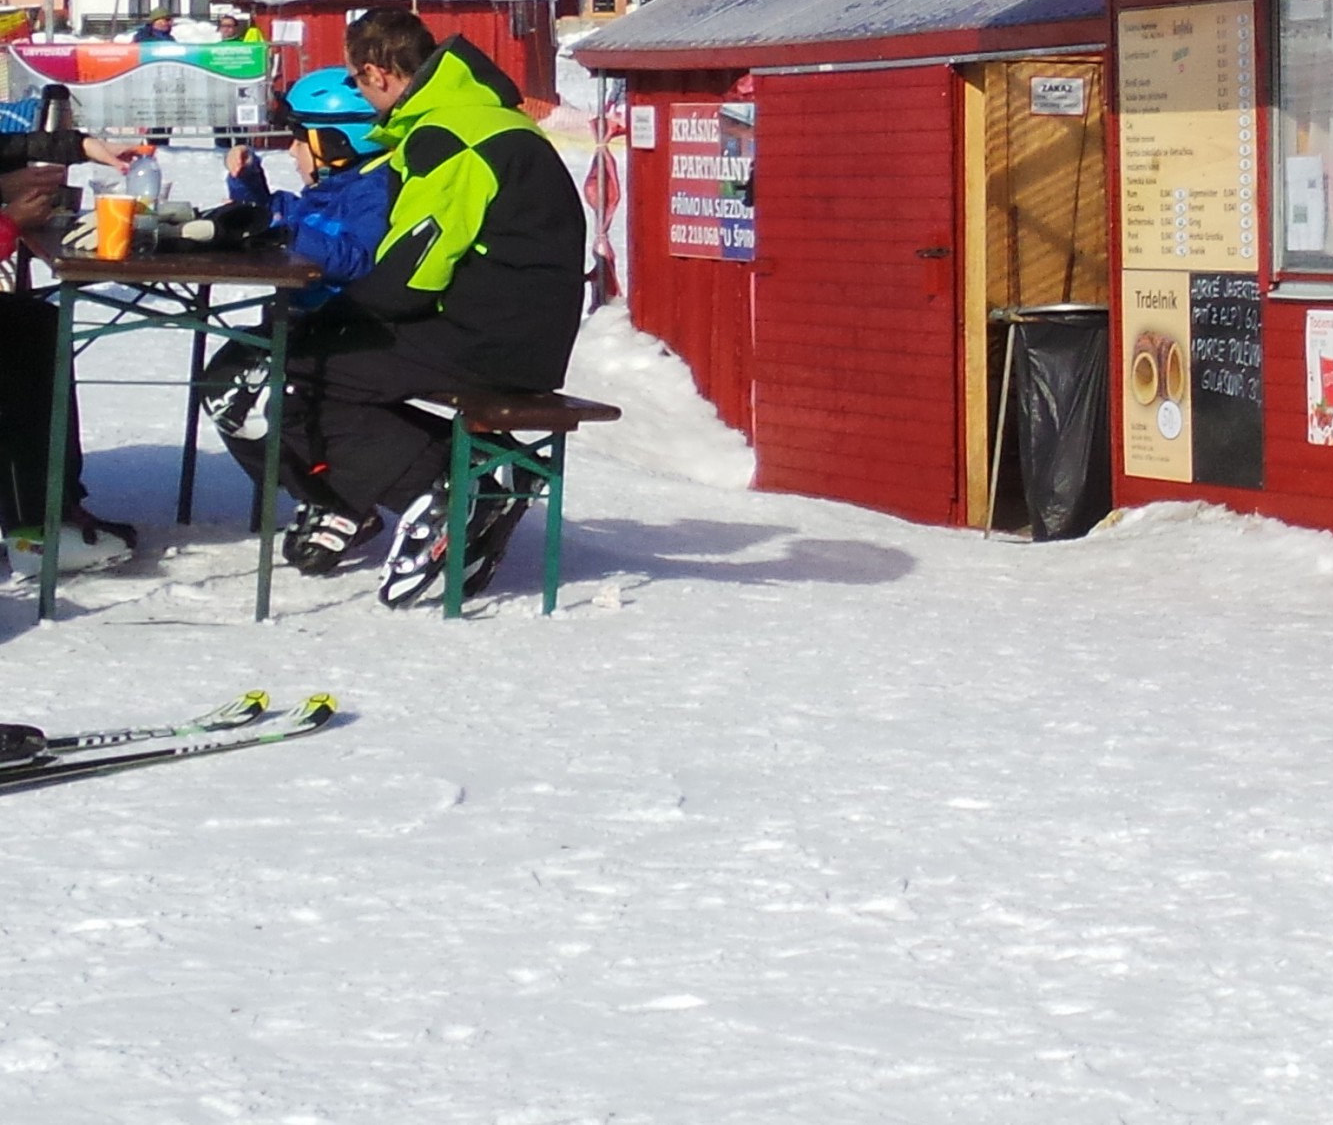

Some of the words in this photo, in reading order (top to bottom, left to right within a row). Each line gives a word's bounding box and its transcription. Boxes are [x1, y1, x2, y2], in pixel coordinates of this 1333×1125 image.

[671, 112, 720, 143] KRÁSNÉ
[672, 150, 751, 183] APARTMÁNY
[671, 192, 701, 217] PŘÍMO
[702, 199, 715, 218] NA
[1135, 290, 1178, 310] Trdelník
